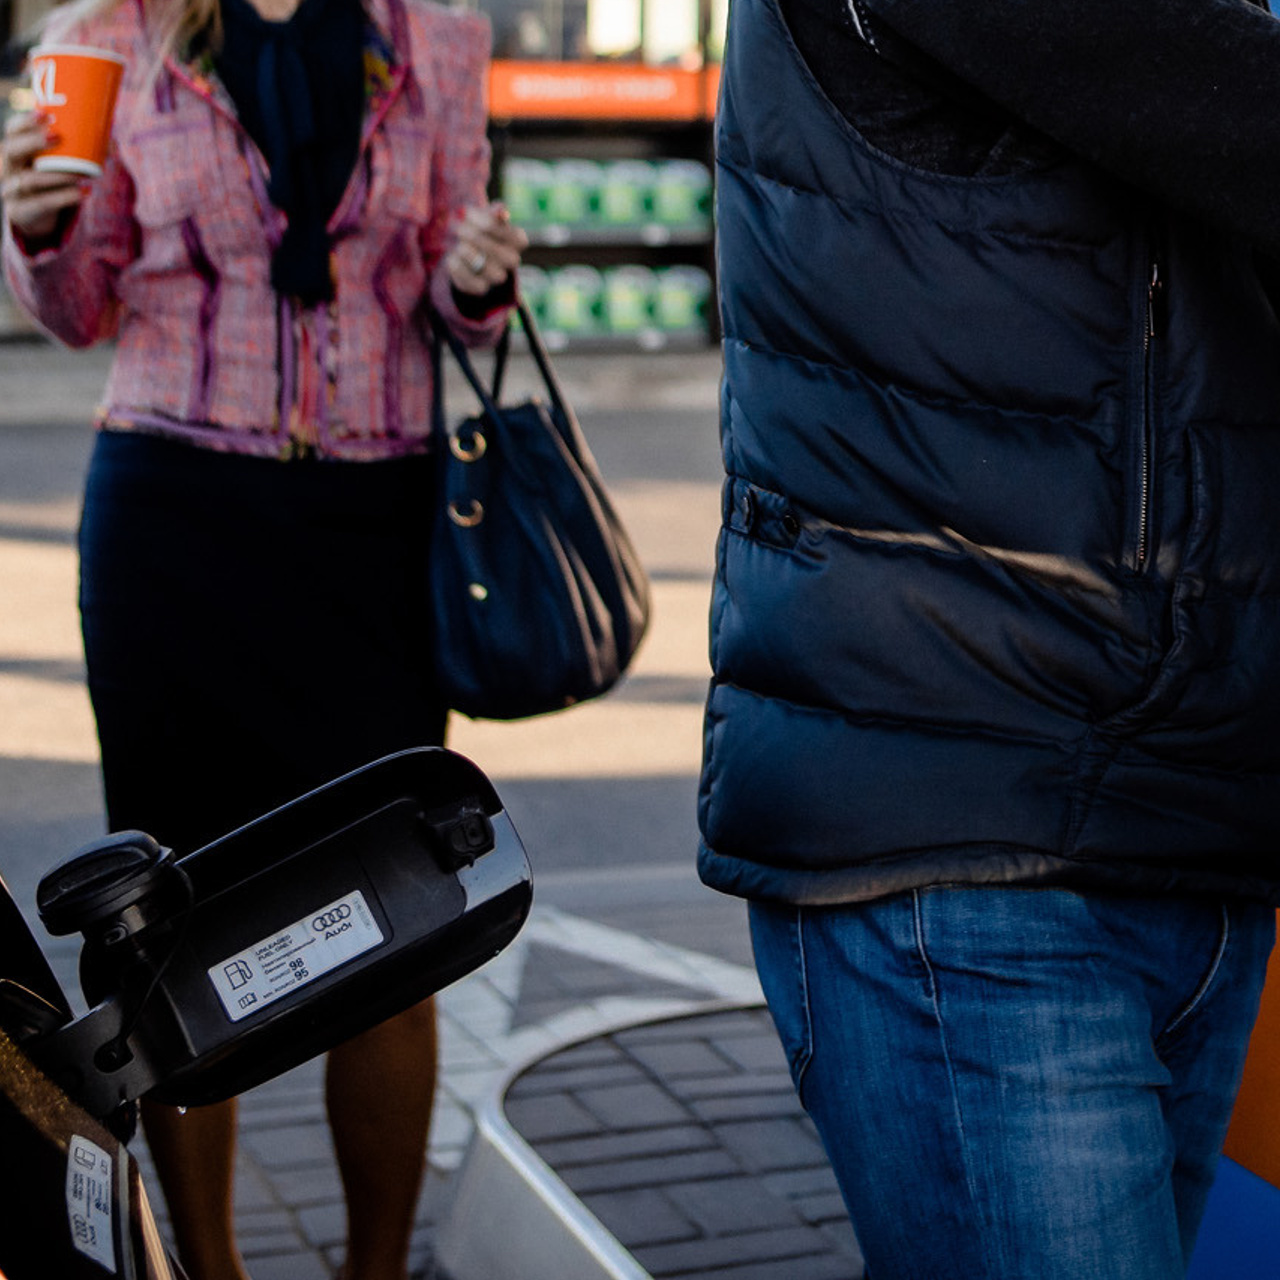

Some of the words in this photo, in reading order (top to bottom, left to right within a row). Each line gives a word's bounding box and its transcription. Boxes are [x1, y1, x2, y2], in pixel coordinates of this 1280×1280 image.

[324, 922, 353, 941] Audi
[289, 957, 304, 971] 98
[294, 967, 309, 981] 95
